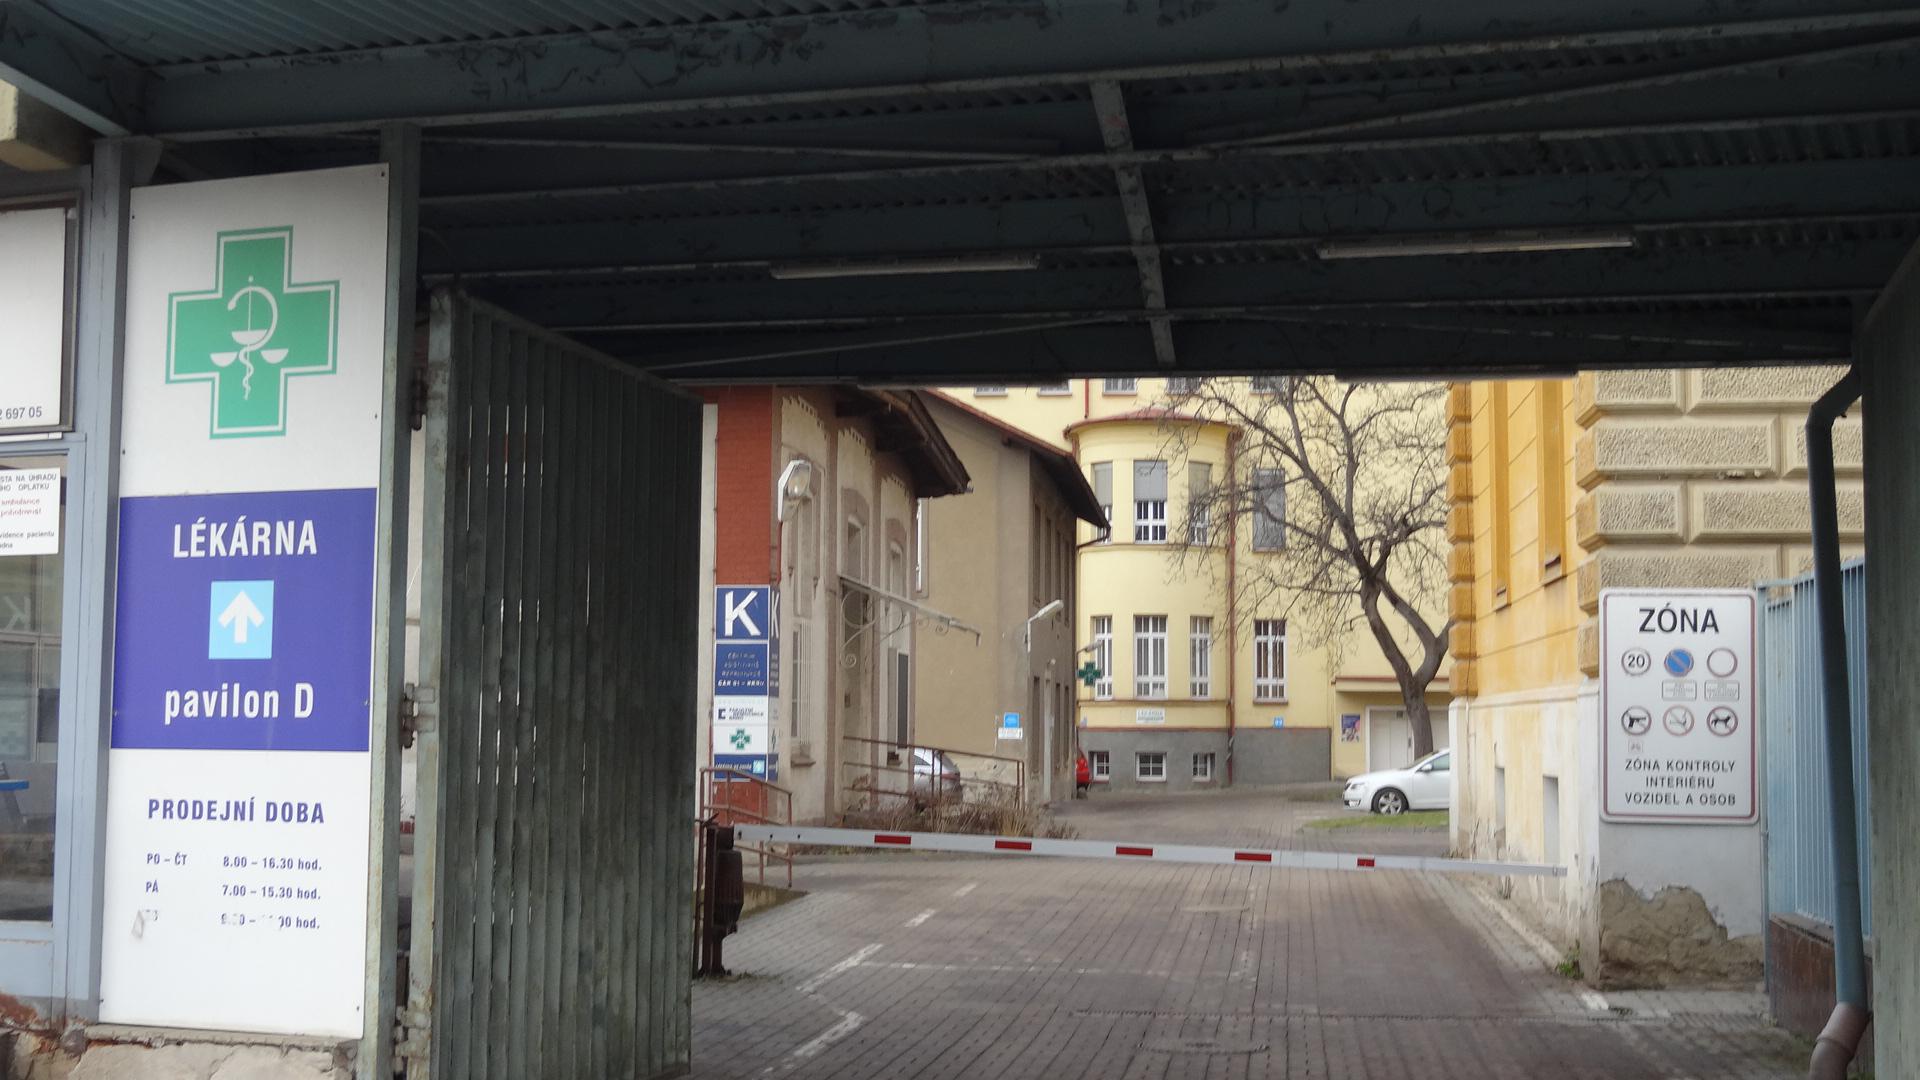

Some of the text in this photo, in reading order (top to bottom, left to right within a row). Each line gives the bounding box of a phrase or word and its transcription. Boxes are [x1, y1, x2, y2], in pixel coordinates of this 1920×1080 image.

[5, 407, 26, 420] 697
[28, 406, 42, 418] 05
[173, 515, 318, 558] LÉKÁRNA
[724, 591, 761, 636] K
[1639, 602, 1720, 634] ZÓNA
[1627, 654, 1646, 669] 20
[164, 682, 315, 725] pavilon D
[1625, 757, 1736, 773] ZÓNA KONTROLY
[1646, 774, 1715, 789] INTERIÉRU
[1625, 791, 1736, 806] VOZIDEL A OSOB
[148, 796, 325, 824] PRODEJNÍ DOBA
[146, 853, 161, 865] PO
[174, 852, 187, 866] ČT
[223, 856, 248, 868] 8.00
[262, 857, 294, 870] 16.30
[297, 859, 322, 871] hod.
[145, 879, 159, 893] PÁ
[222, 884, 247, 897] 7.00
[261, 886, 293, 899] 15.30
[296, 887, 321, 900] hod.
[295, 916, 321, 930] hod.
